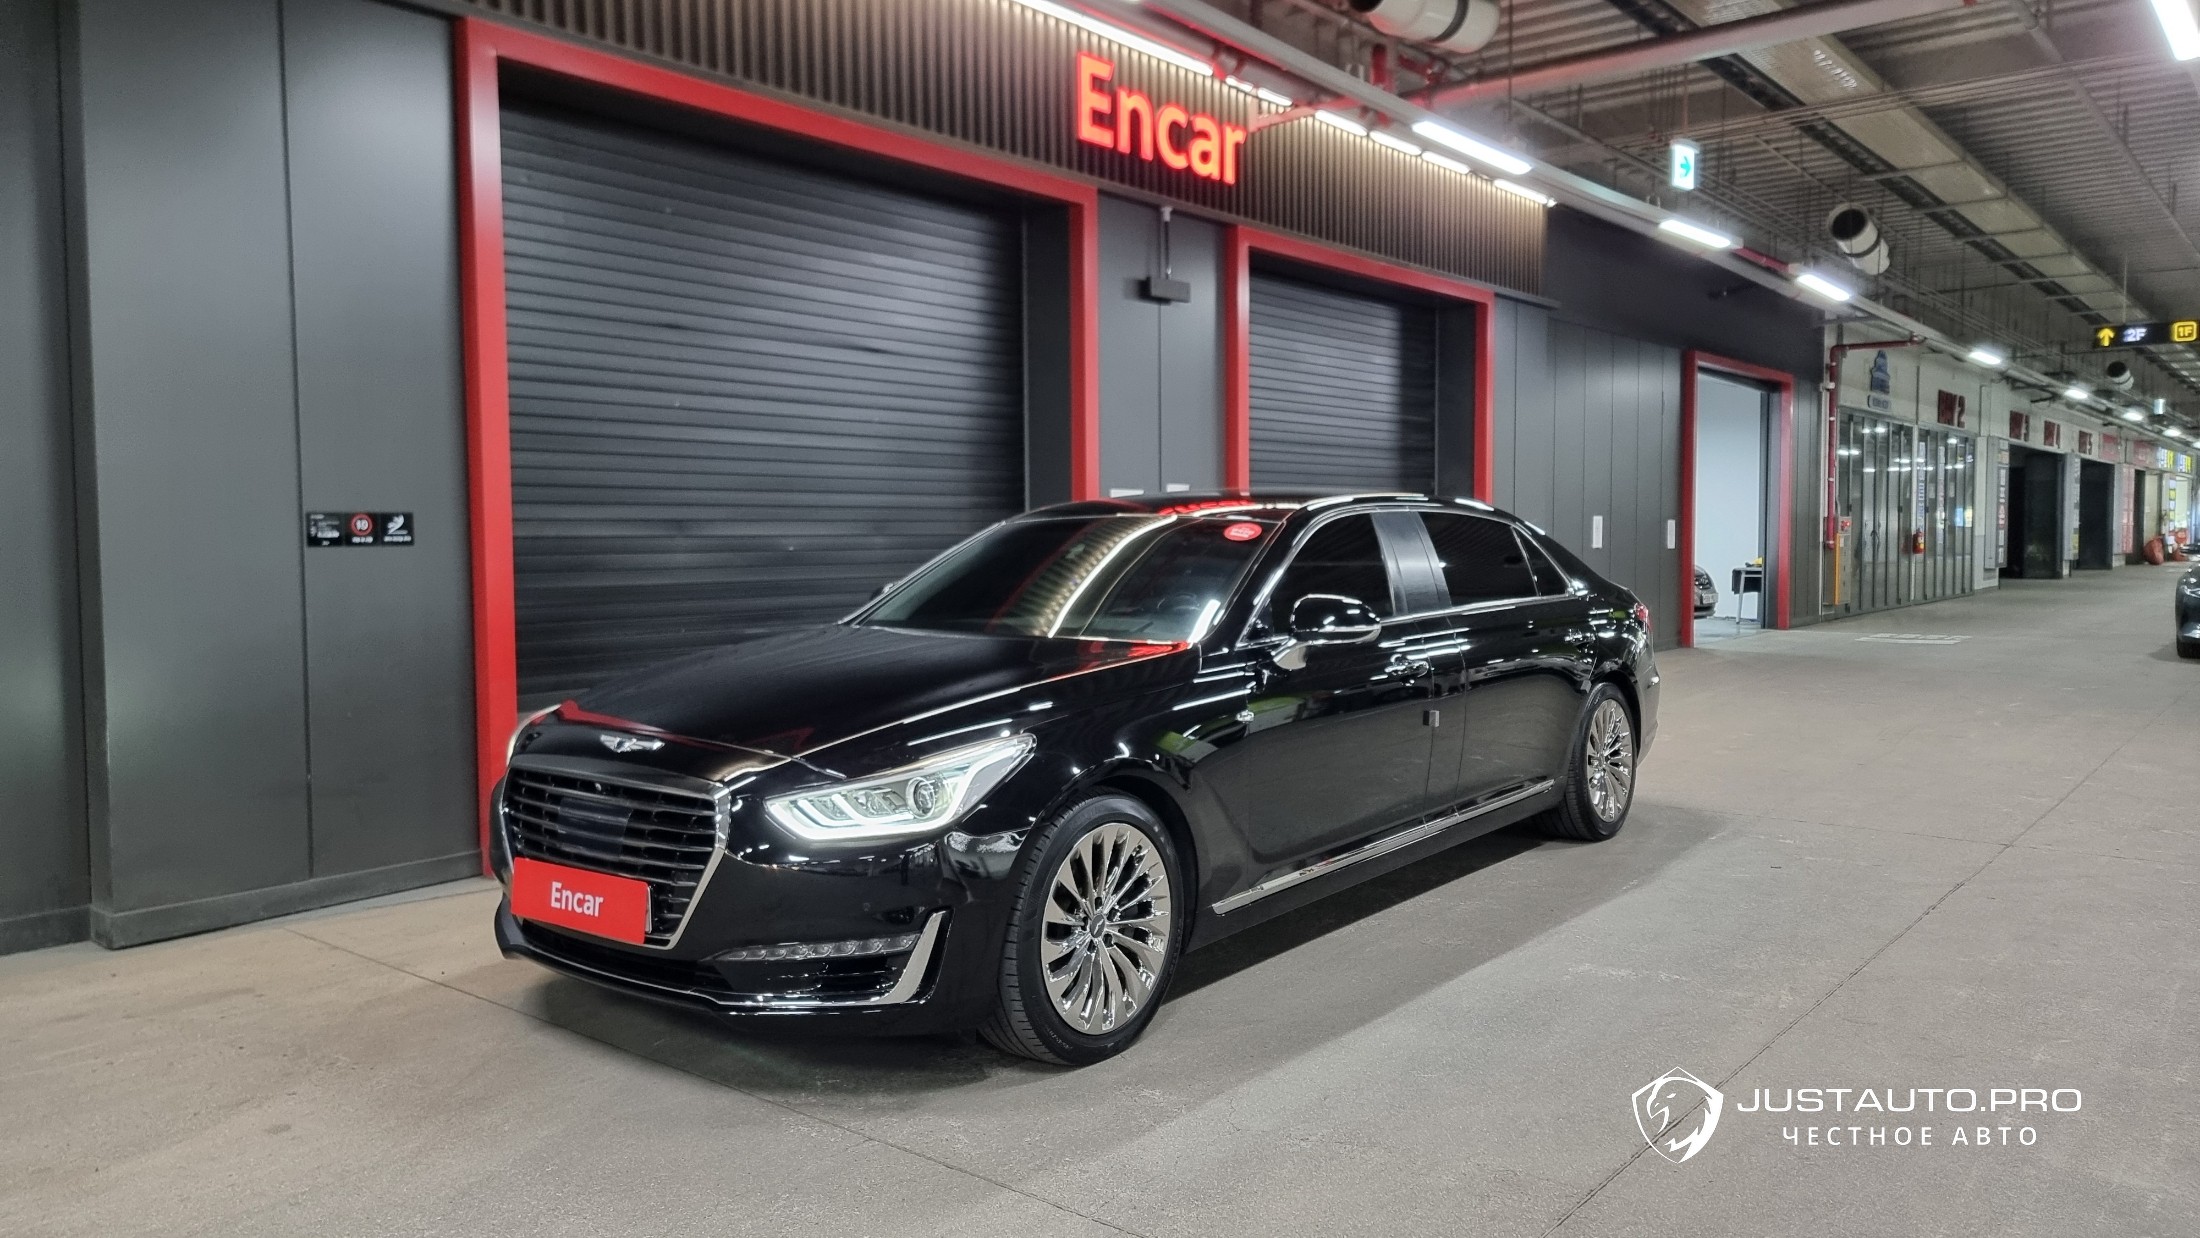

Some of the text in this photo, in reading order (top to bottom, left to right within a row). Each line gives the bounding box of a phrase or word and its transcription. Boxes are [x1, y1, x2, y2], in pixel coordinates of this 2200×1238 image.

[1077, 52, 1247, 186] Encar
[2124, 327, 2192, 342] 2F 1F
[550, 881, 604, 917] Encar
